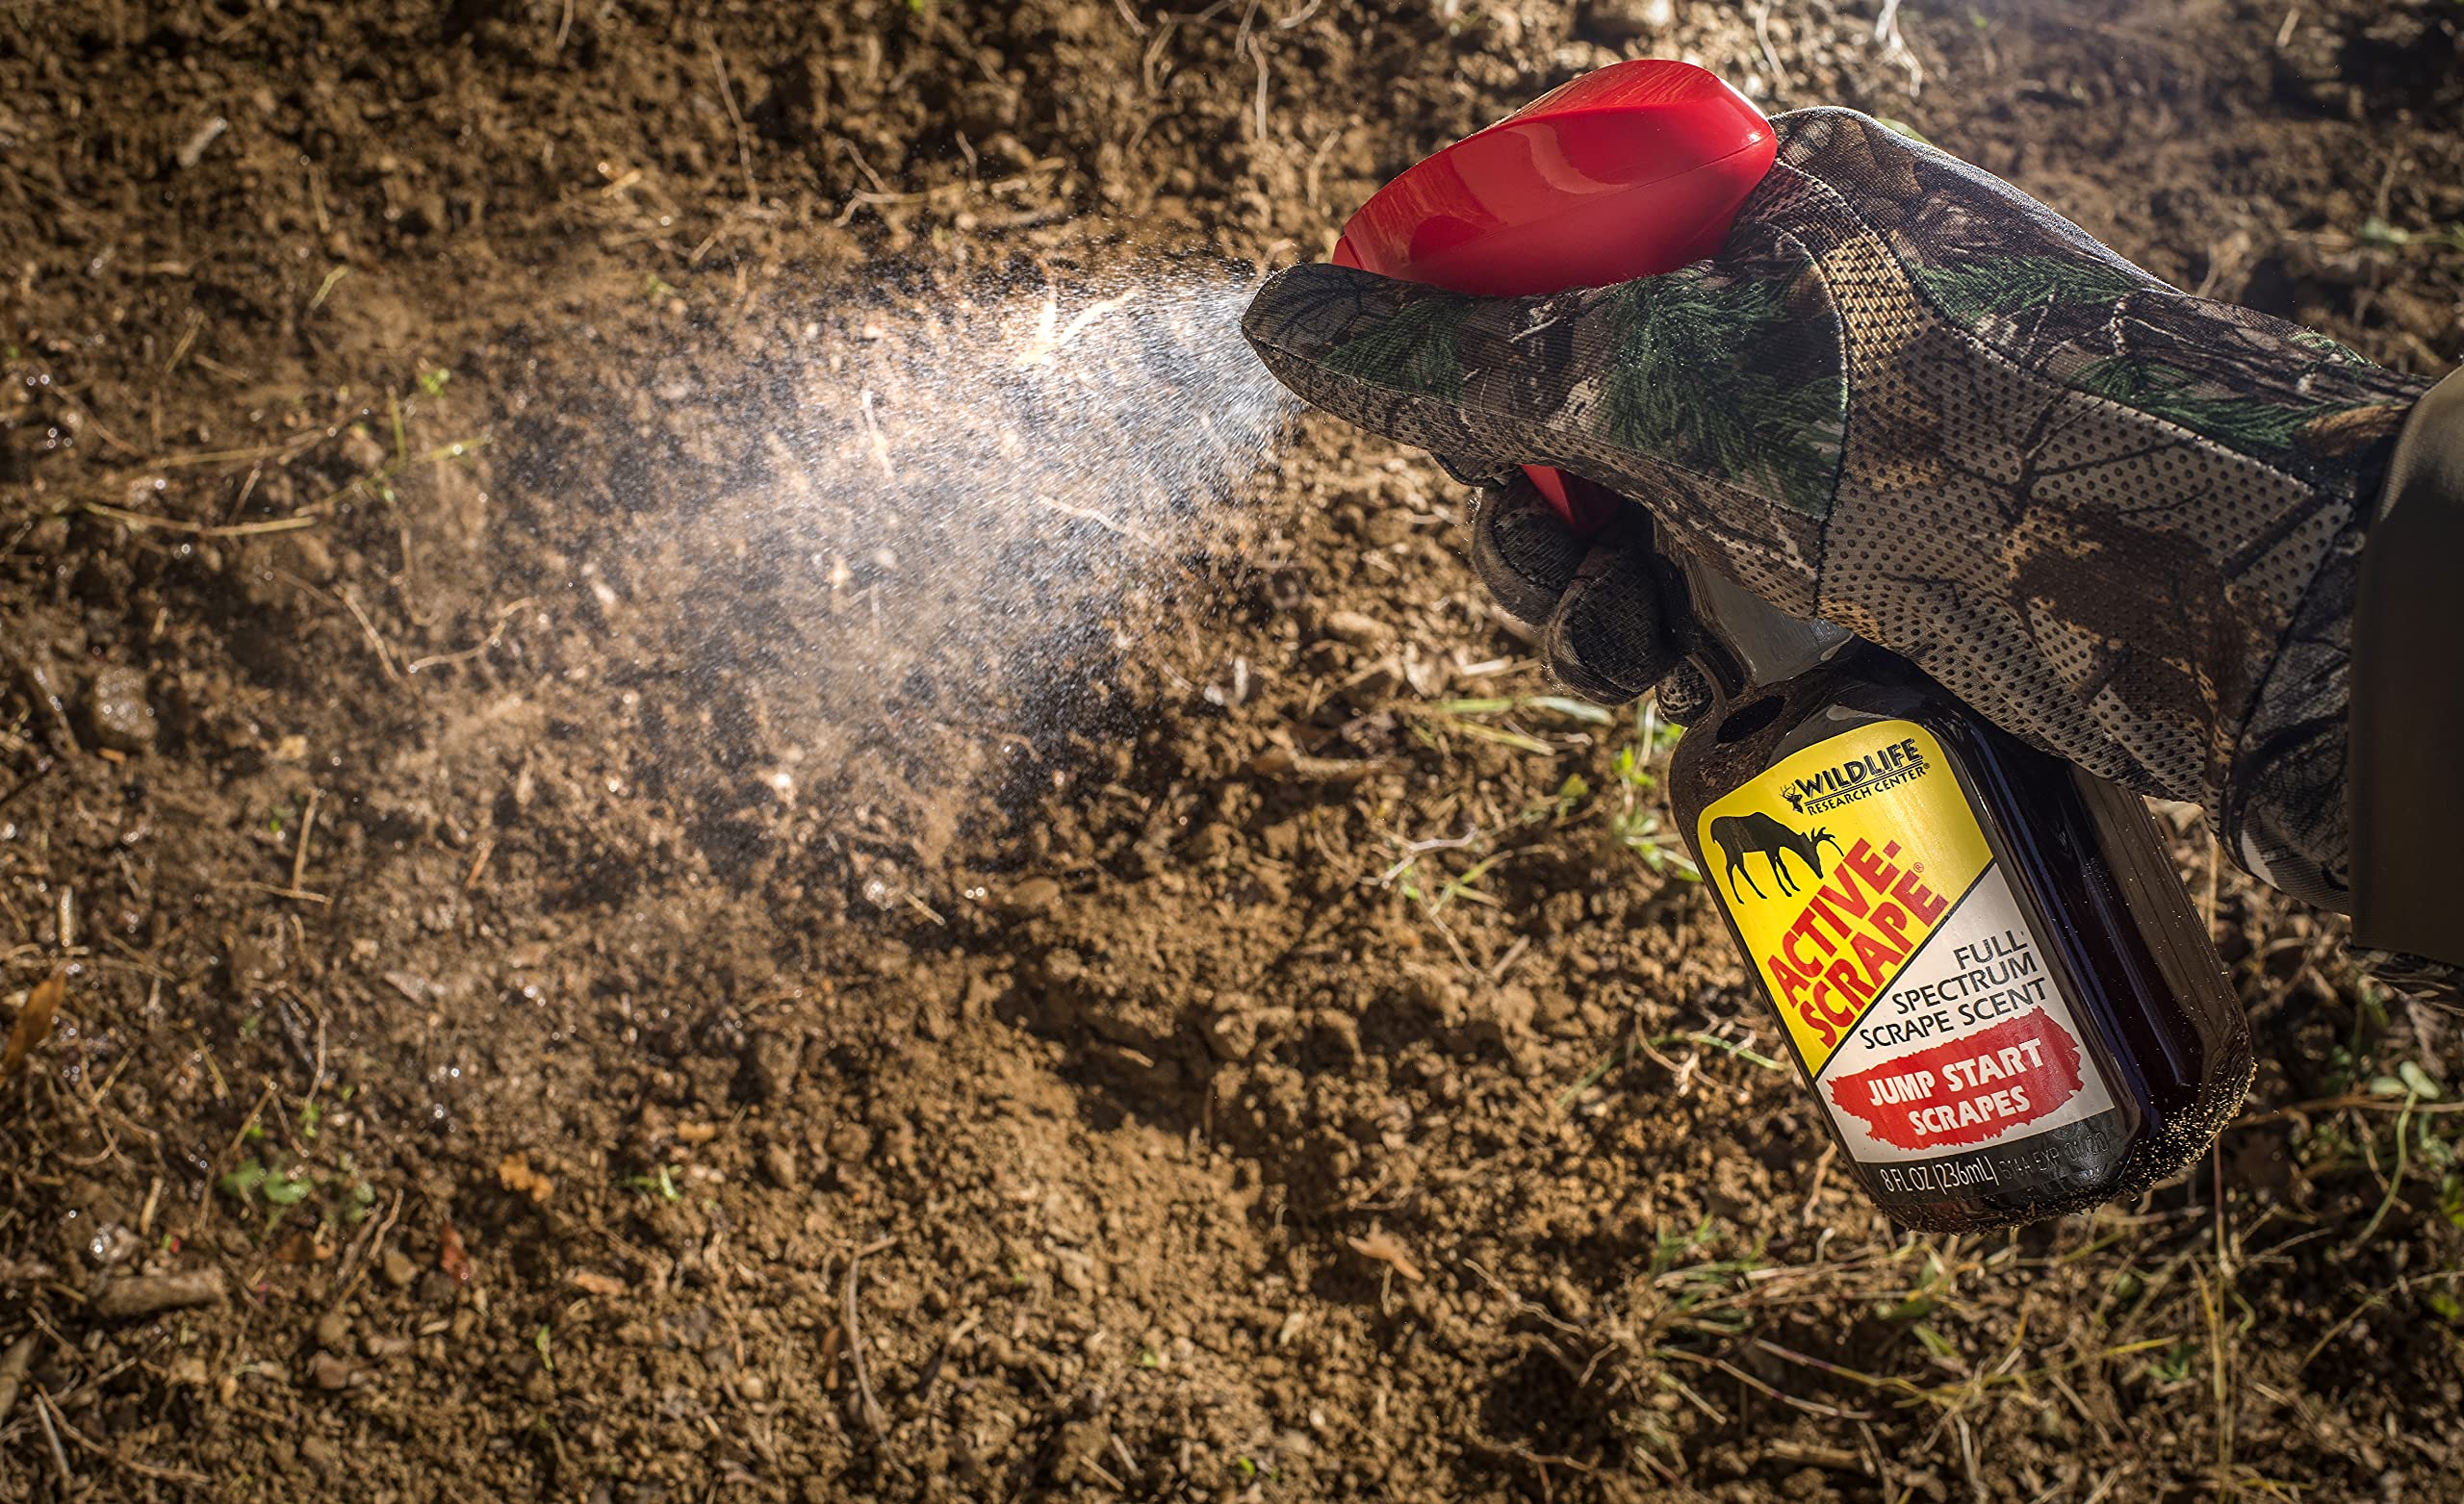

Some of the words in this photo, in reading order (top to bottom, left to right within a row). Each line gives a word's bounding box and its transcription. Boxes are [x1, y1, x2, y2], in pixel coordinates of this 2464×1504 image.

[1795, 738, 1923, 799] WILDLIFE
[1807, 787, 1872, 816] RESEARCH
[1954, 930, 2028, 970] FULL
[1892, 952, 2038, 1015] SPECTRUM
[1860, 1010, 1954, 1050] SCRAPE
[1958, 977, 2046, 1027] SCENT
[1867, 1070, 1936, 1107] JUMP
[1941, 1037, 2043, 1092] START
[1908, 1085, 2031, 1135] SCRAPES
[1880, 1168, 1895, 1192] 8
[1892, 1167, 1912, 1191] FL
[1909, 1165, 1936, 1190] OZ
